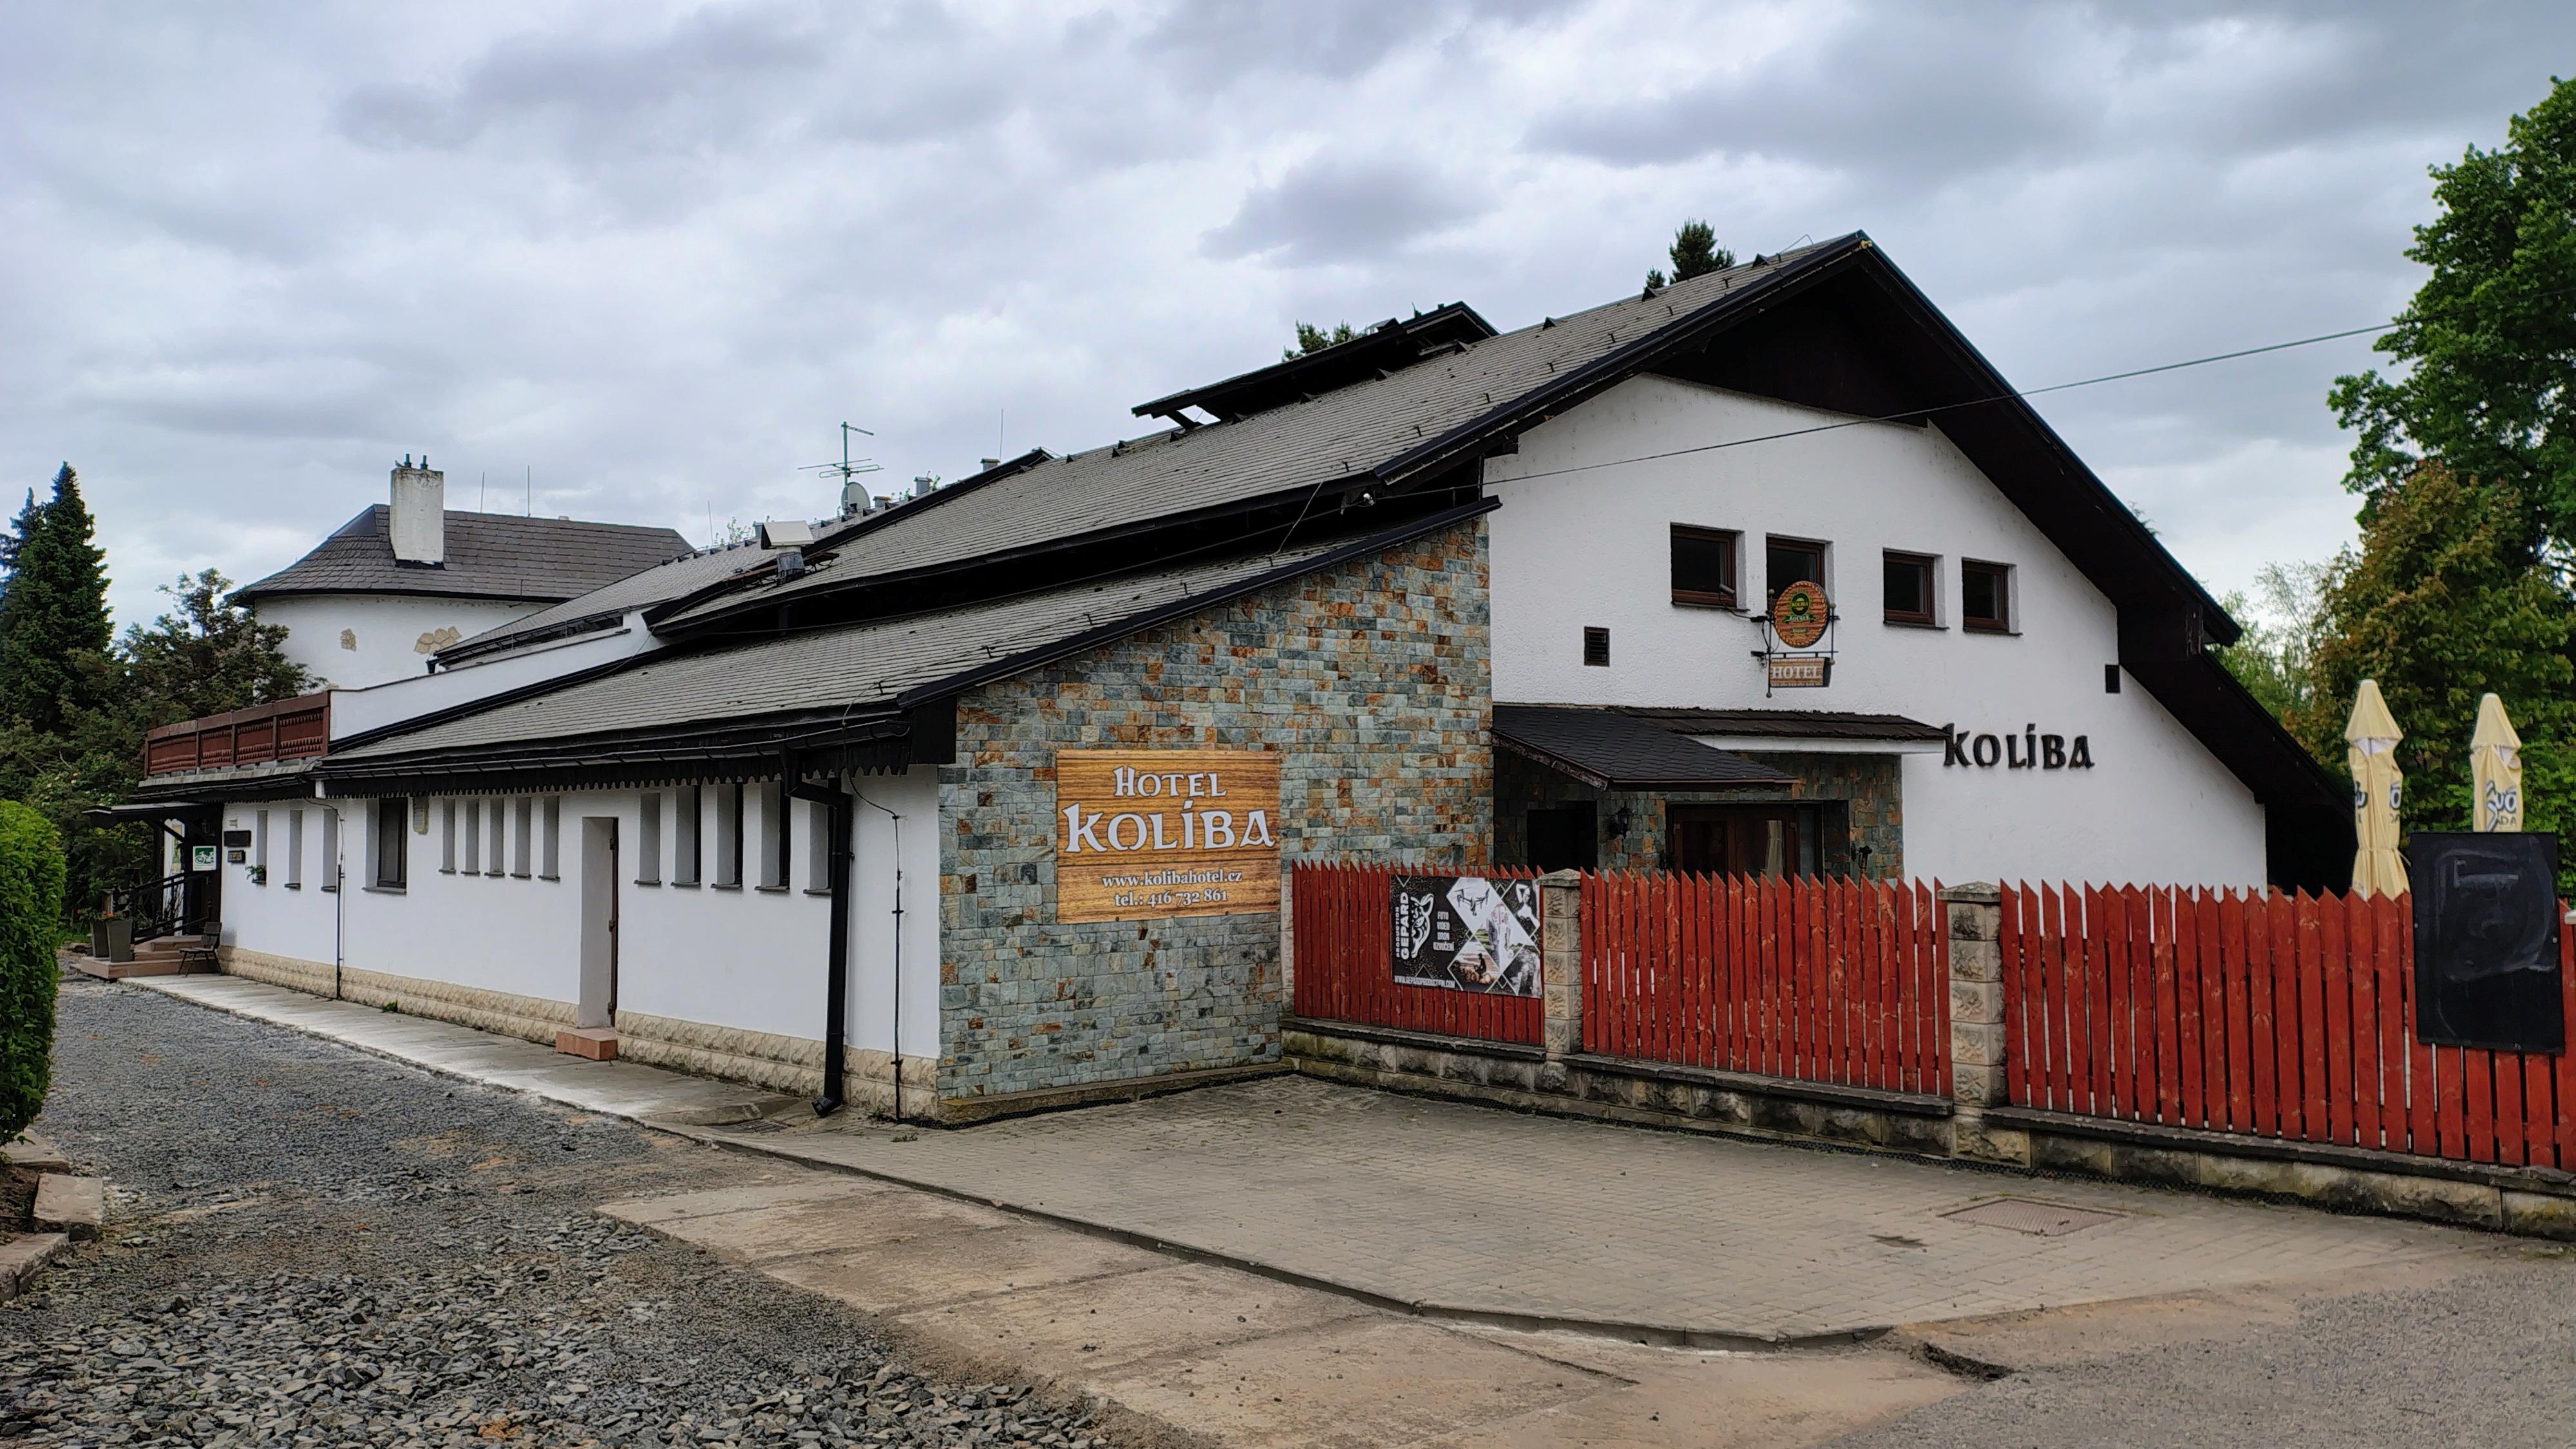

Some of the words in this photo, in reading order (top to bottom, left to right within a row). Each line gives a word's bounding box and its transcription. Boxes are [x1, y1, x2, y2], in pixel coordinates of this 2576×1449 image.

[1772, 665, 1821, 679] HOTEL
[1942, 723, 2095, 769] KOLÍBA
[1113, 766, 1227, 797] HOTEL
[1062, 799, 1276, 853] KOLÍBA
[1102, 869, 1242, 888] www.kolibahotel.cz
[1114, 893, 1144, 907] tel.:
[1147, 890, 1171, 907] 416
[1175, 891, 1200, 906] 732
[1203, 889, 1227, 902] 861
[1400, 892, 1409, 960] GEPARD
[1437, 911, 1449, 920] FOTO
